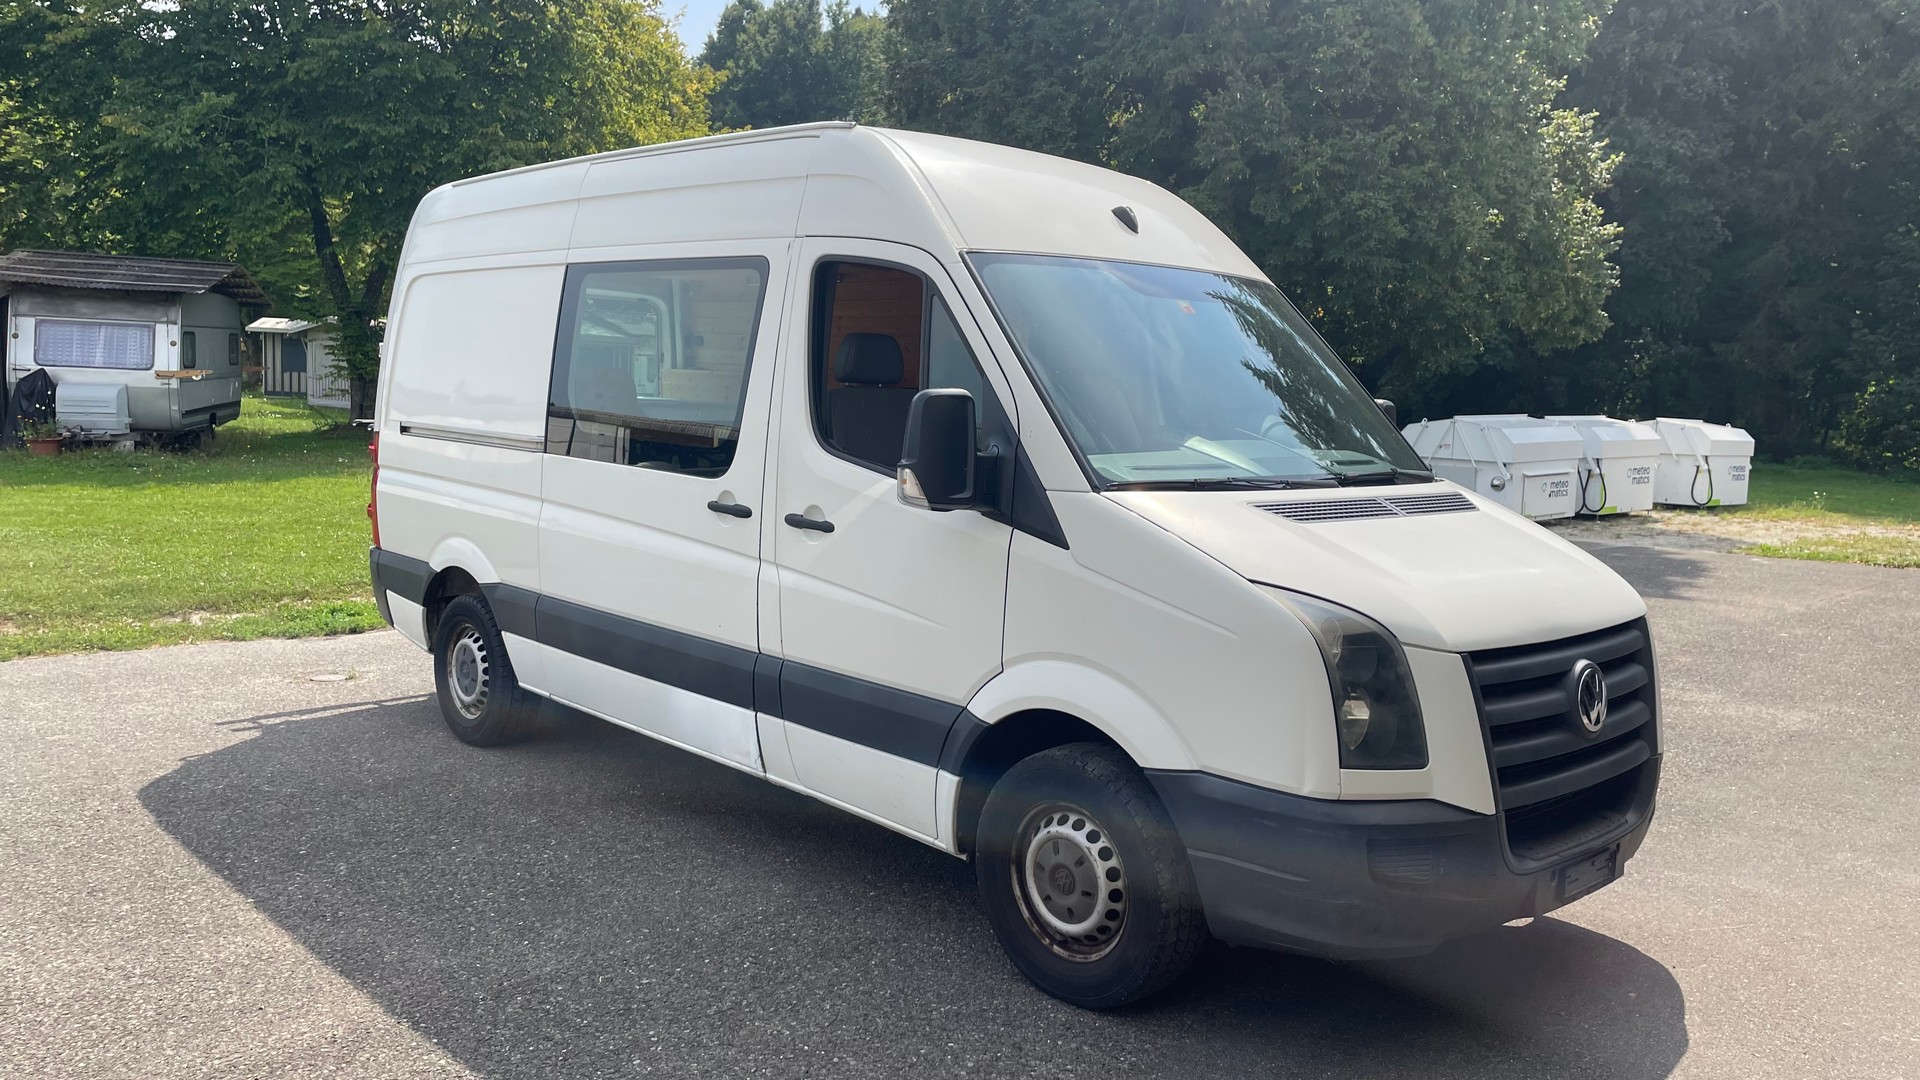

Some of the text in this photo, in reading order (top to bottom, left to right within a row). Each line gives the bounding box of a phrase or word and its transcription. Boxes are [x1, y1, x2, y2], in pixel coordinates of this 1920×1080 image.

[1632, 466, 1650, 476] meteo
[1550, 480, 1569, 489] meteo
[1632, 476, 1650, 484] matics
[1550, 488, 1568, 498] matics
